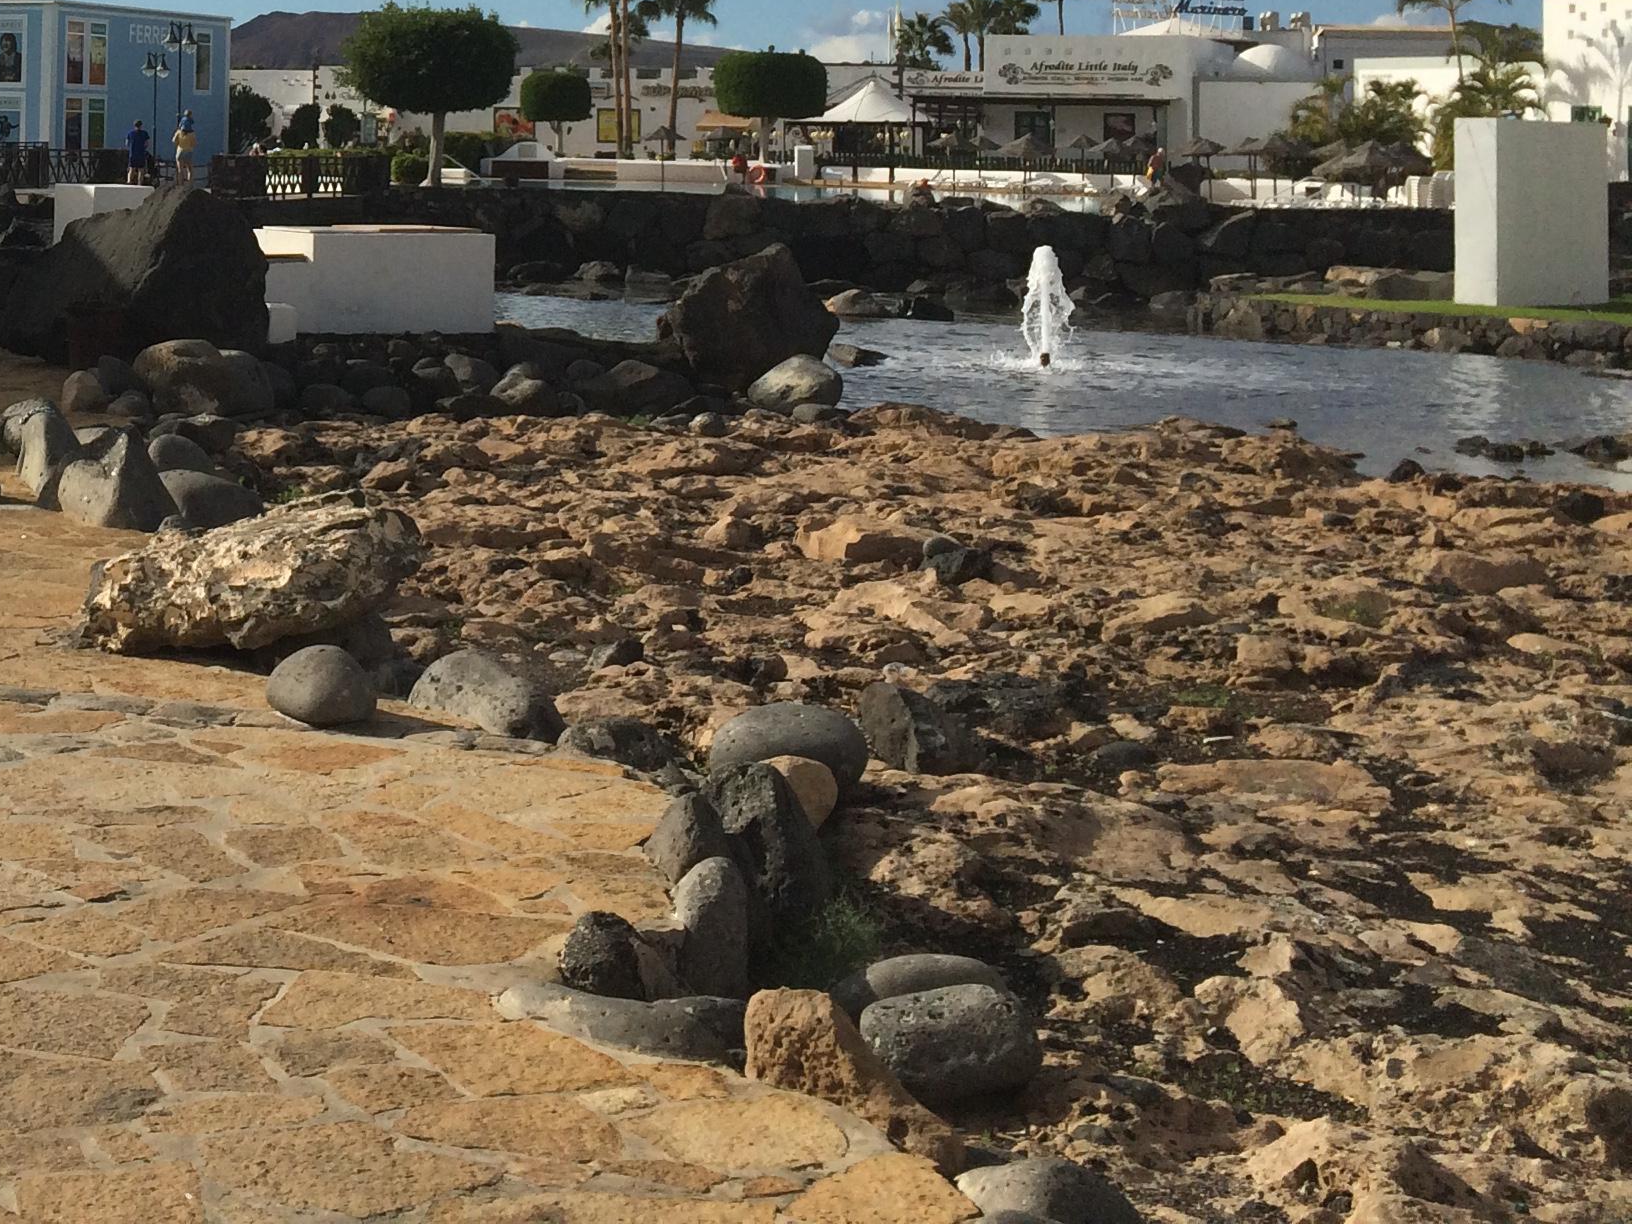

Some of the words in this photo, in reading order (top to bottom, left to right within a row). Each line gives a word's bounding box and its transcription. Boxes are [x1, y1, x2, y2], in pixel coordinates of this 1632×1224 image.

[1030, 60, 1074, 75] Afrodite
[1076, 60, 1108, 72] Little
[1112, 60, 1139, 74] Italy
